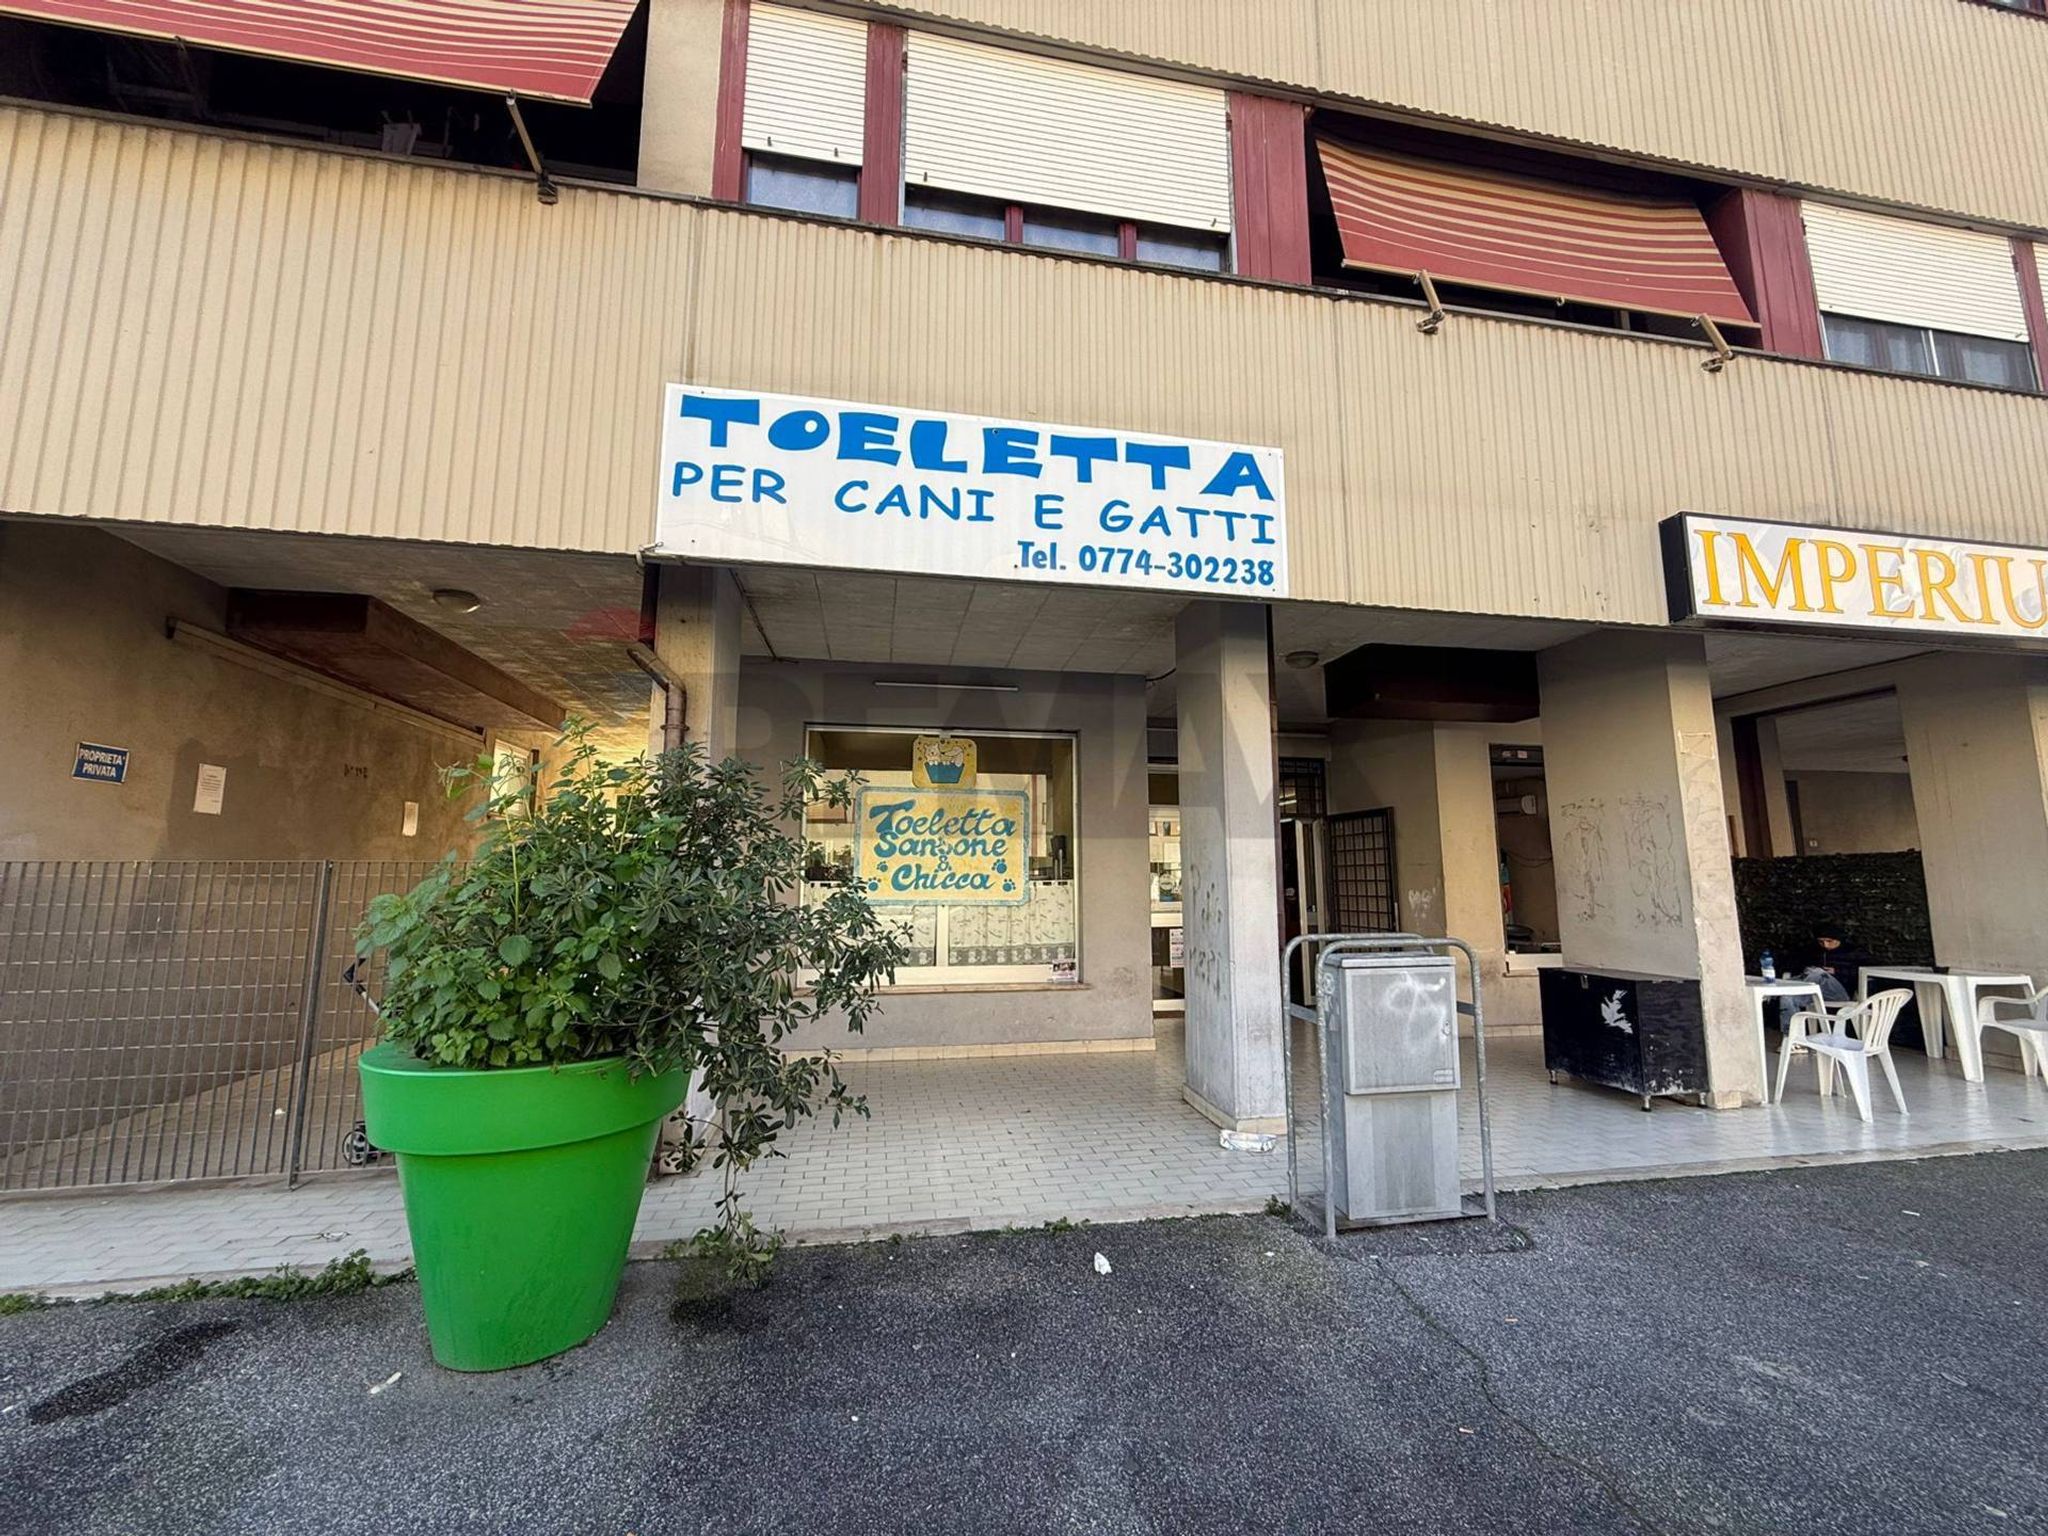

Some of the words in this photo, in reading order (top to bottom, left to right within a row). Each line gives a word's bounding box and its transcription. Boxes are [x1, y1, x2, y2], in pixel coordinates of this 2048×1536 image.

[680, 394, 1276, 501] TOELETTA
[671, 460, 787, 505] PER
[834, 479, 996, 523] CANI
[1034, 494, 1065, 531] E
[1098, 498, 1277, 546] GATTI
[1016, 539, 1067, 571] Tel.
[1078, 542, 1276, 586] 0774-302238
[82, 762, 117, 778] PRIVATA
[869, 800, 1016, 836] Toeletta
[891, 864, 994, 891] Chicca
